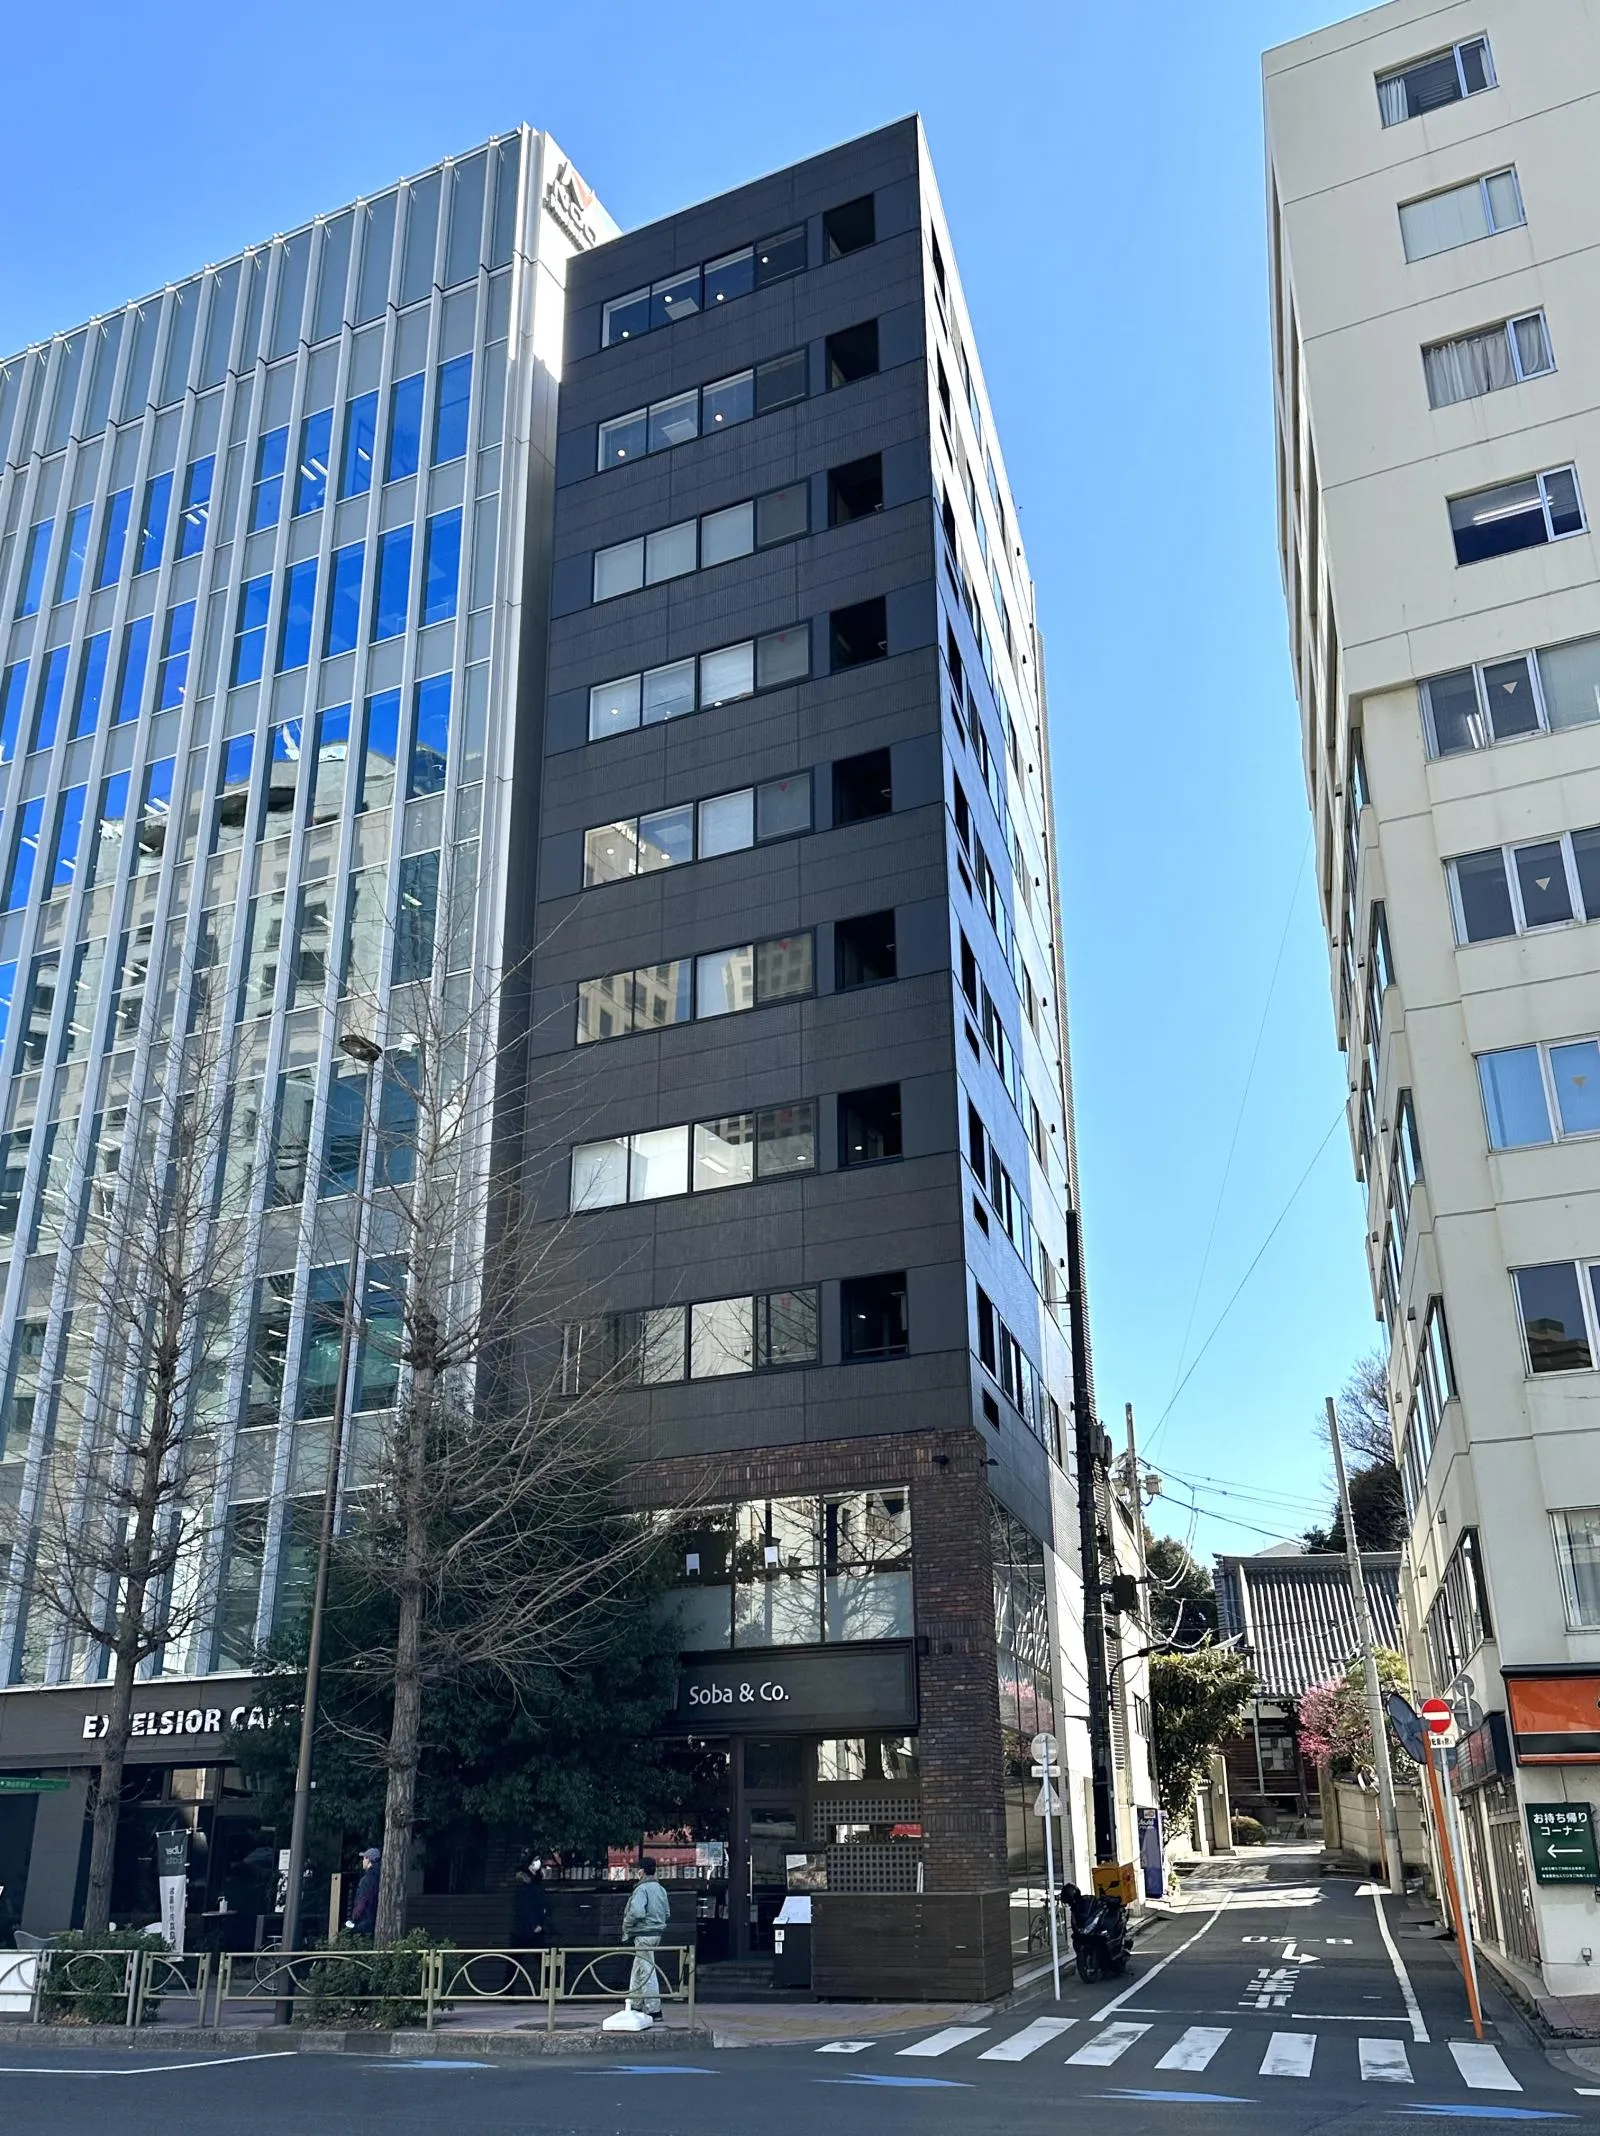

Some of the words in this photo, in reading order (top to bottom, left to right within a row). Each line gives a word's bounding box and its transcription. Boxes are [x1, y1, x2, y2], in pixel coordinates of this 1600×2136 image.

[689, 1683, 733, 1705] Soba
[739, 1682, 755, 1702] &
[760, 1681, 789, 1701] Co.
[82, 1708, 221, 1738] EXELSIOR
[1533, 1812, 1588, 1824] お持ち帰り
[1540, 1825, 1585, 1836] コーナー
